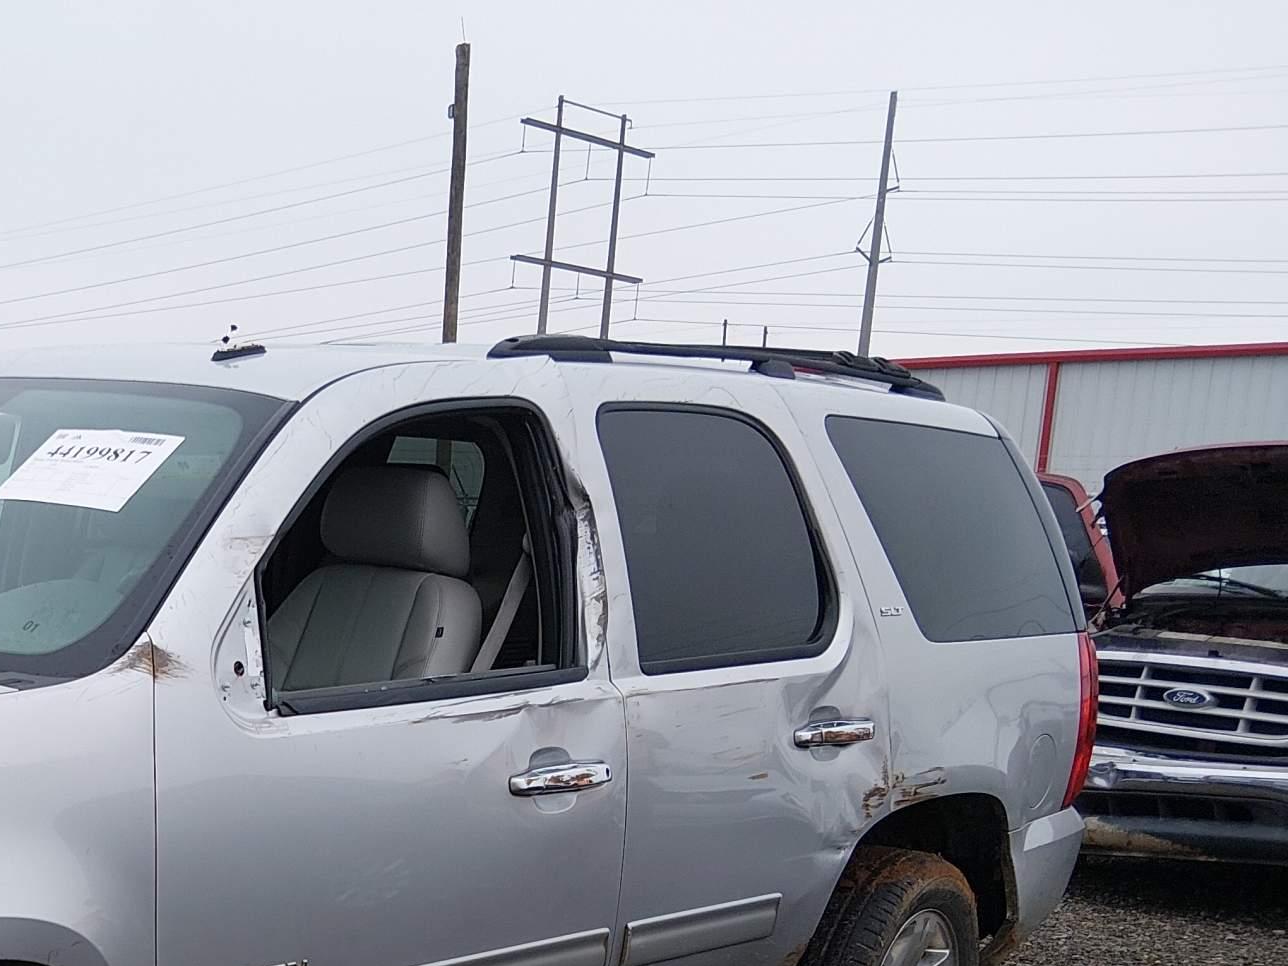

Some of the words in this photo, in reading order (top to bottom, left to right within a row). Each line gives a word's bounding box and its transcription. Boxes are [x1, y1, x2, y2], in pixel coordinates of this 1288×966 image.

[48, 444, 153, 464] 44199817
[880, 606, 904, 617] SLT
[1173, 691, 1200, 704] Ford
